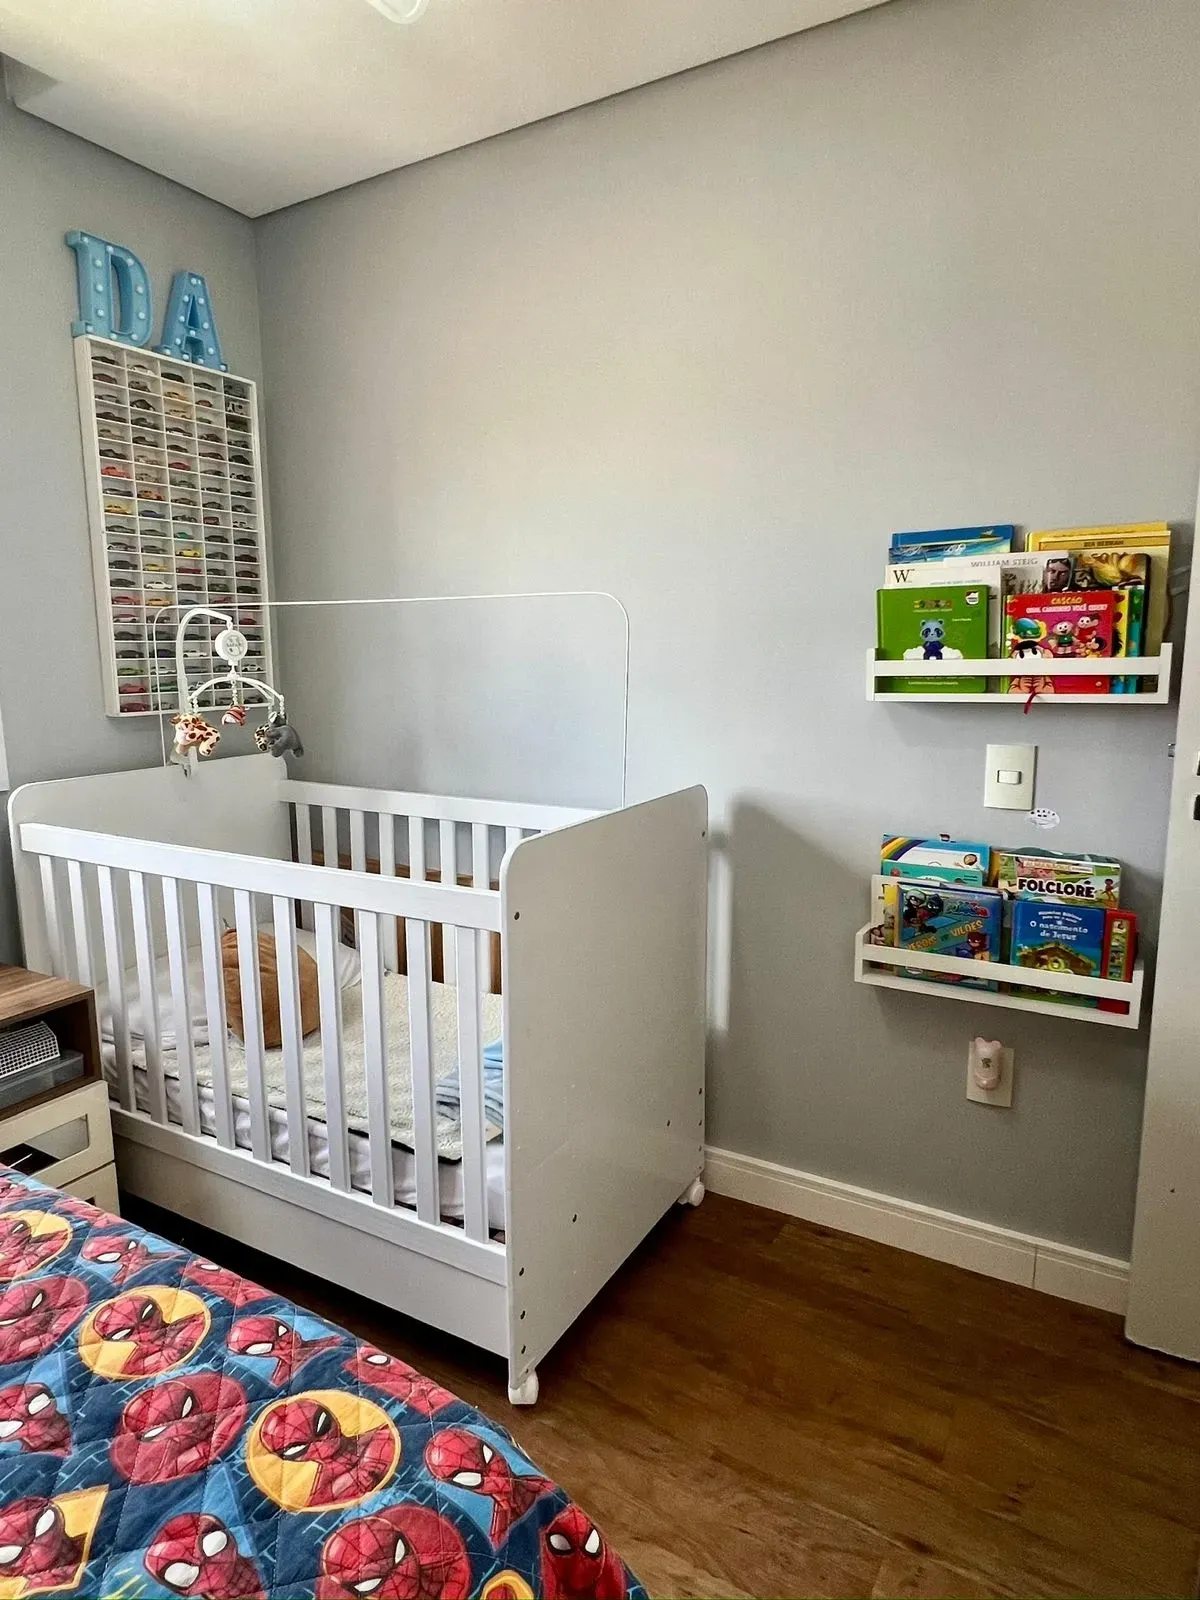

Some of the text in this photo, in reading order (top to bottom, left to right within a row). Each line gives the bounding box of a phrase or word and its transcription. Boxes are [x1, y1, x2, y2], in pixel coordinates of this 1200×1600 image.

[970, 558, 1039, 568] WILLIAM STEIG
[1018, 878, 1096, 898] FOLCLORE
[1030, 920, 1088, 933] O nascimento
